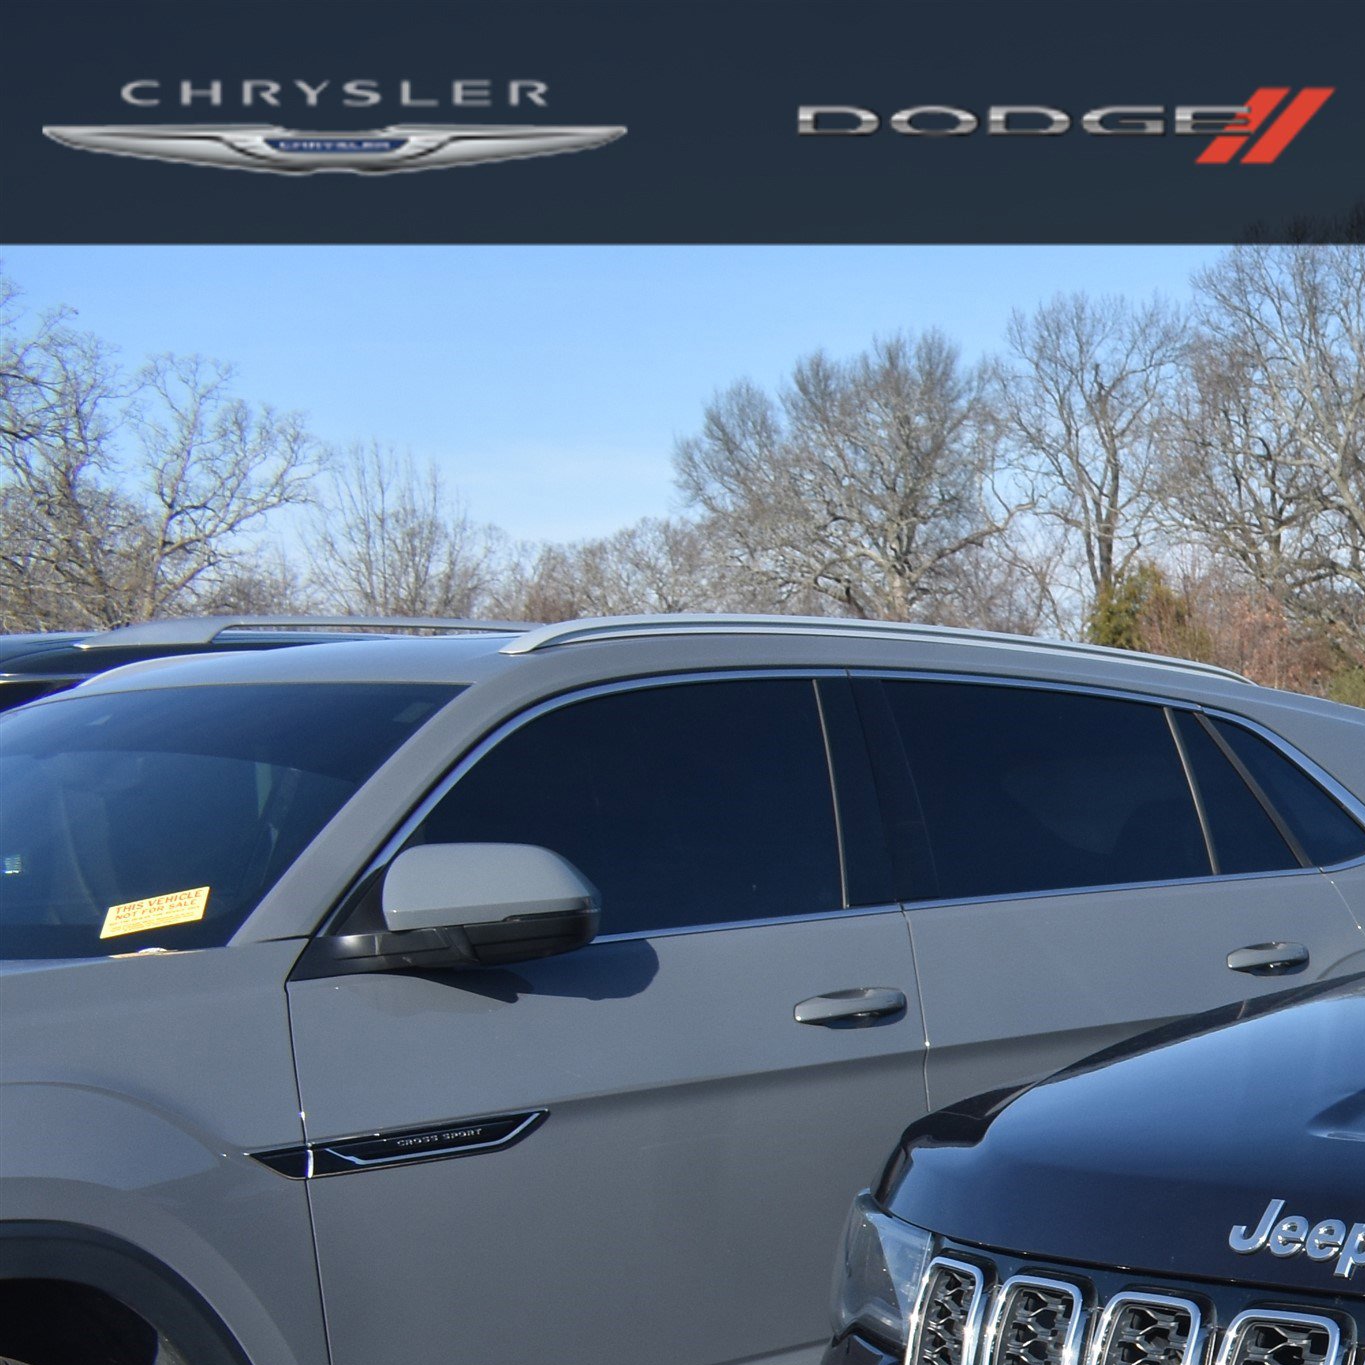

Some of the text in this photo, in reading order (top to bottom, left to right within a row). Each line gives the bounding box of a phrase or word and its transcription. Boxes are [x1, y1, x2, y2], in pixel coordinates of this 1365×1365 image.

[115, 889, 203, 915] THIS VEHICLE
[115, 911, 137, 921] NOT
[141, 905, 165, 915] FOR
[169, 899, 197, 910] SALE
